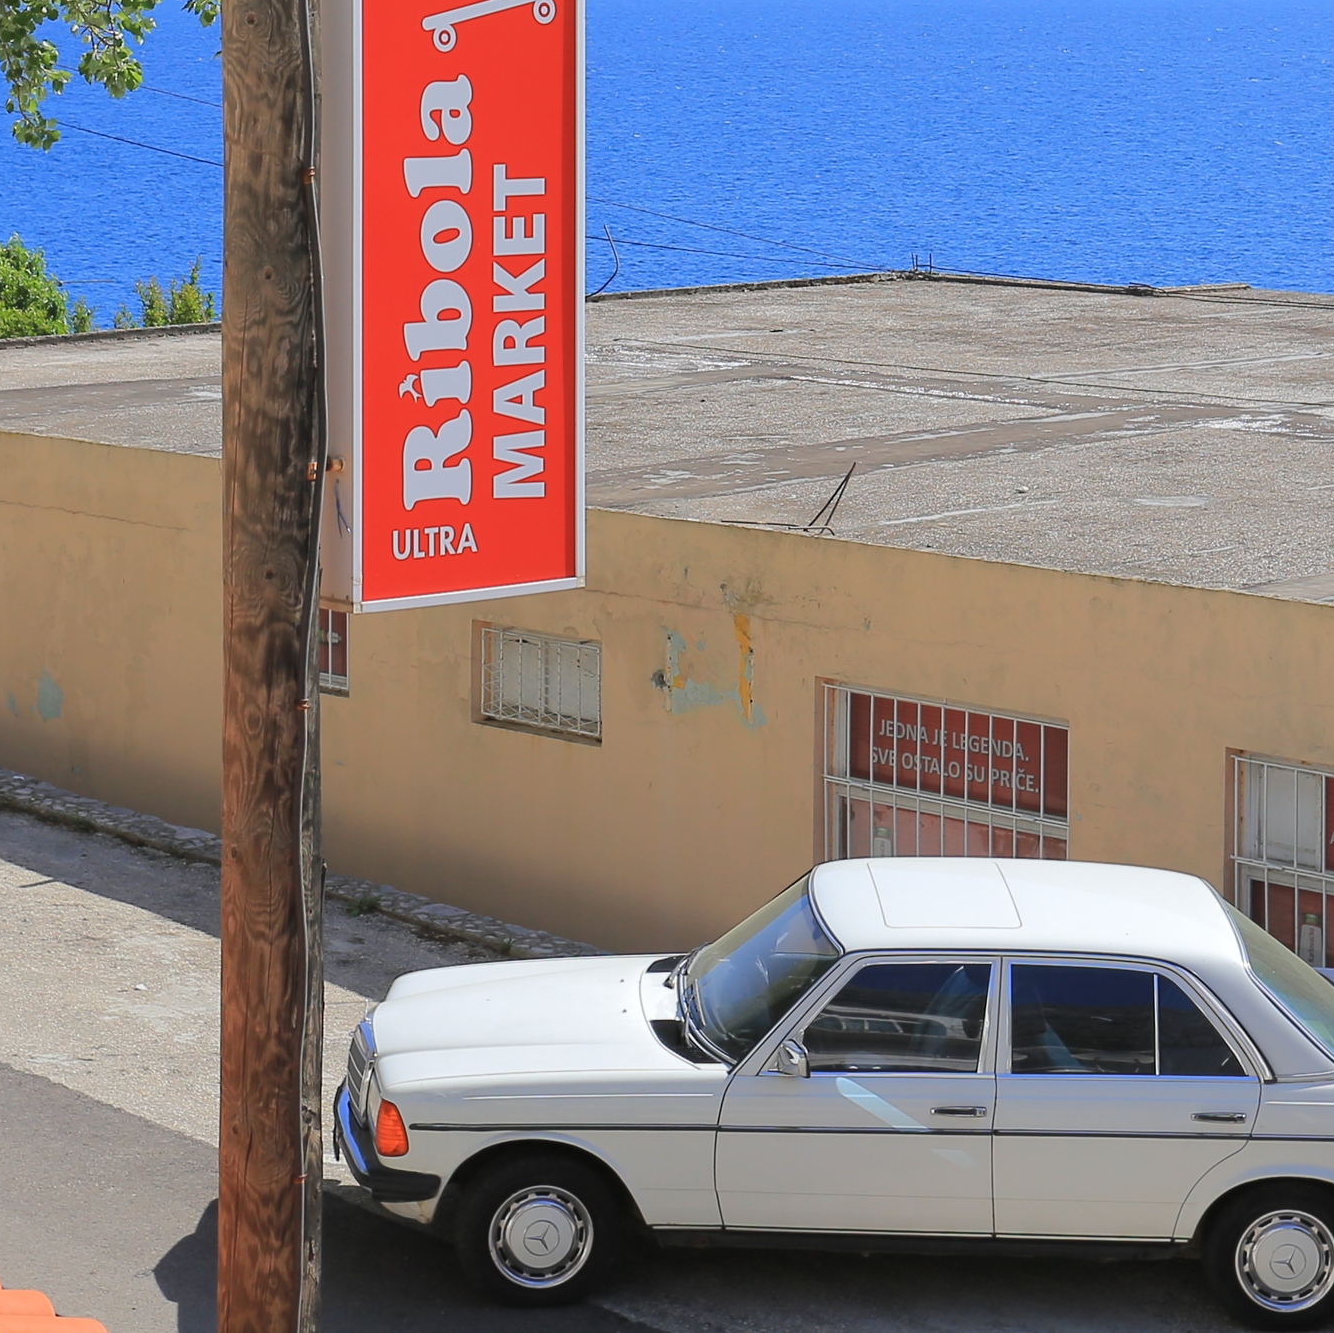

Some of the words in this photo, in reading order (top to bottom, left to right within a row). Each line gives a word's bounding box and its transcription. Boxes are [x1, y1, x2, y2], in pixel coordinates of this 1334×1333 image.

[399, 75, 472, 510] Ribola
[493, 164, 545, 498] MARKET
[393, 523, 477, 559] ULTRA
[879, 719, 929, 744] JEDNA
[932, 729, 948, 748] JE
[952, 732, 1029, 762] LEGENDA.
